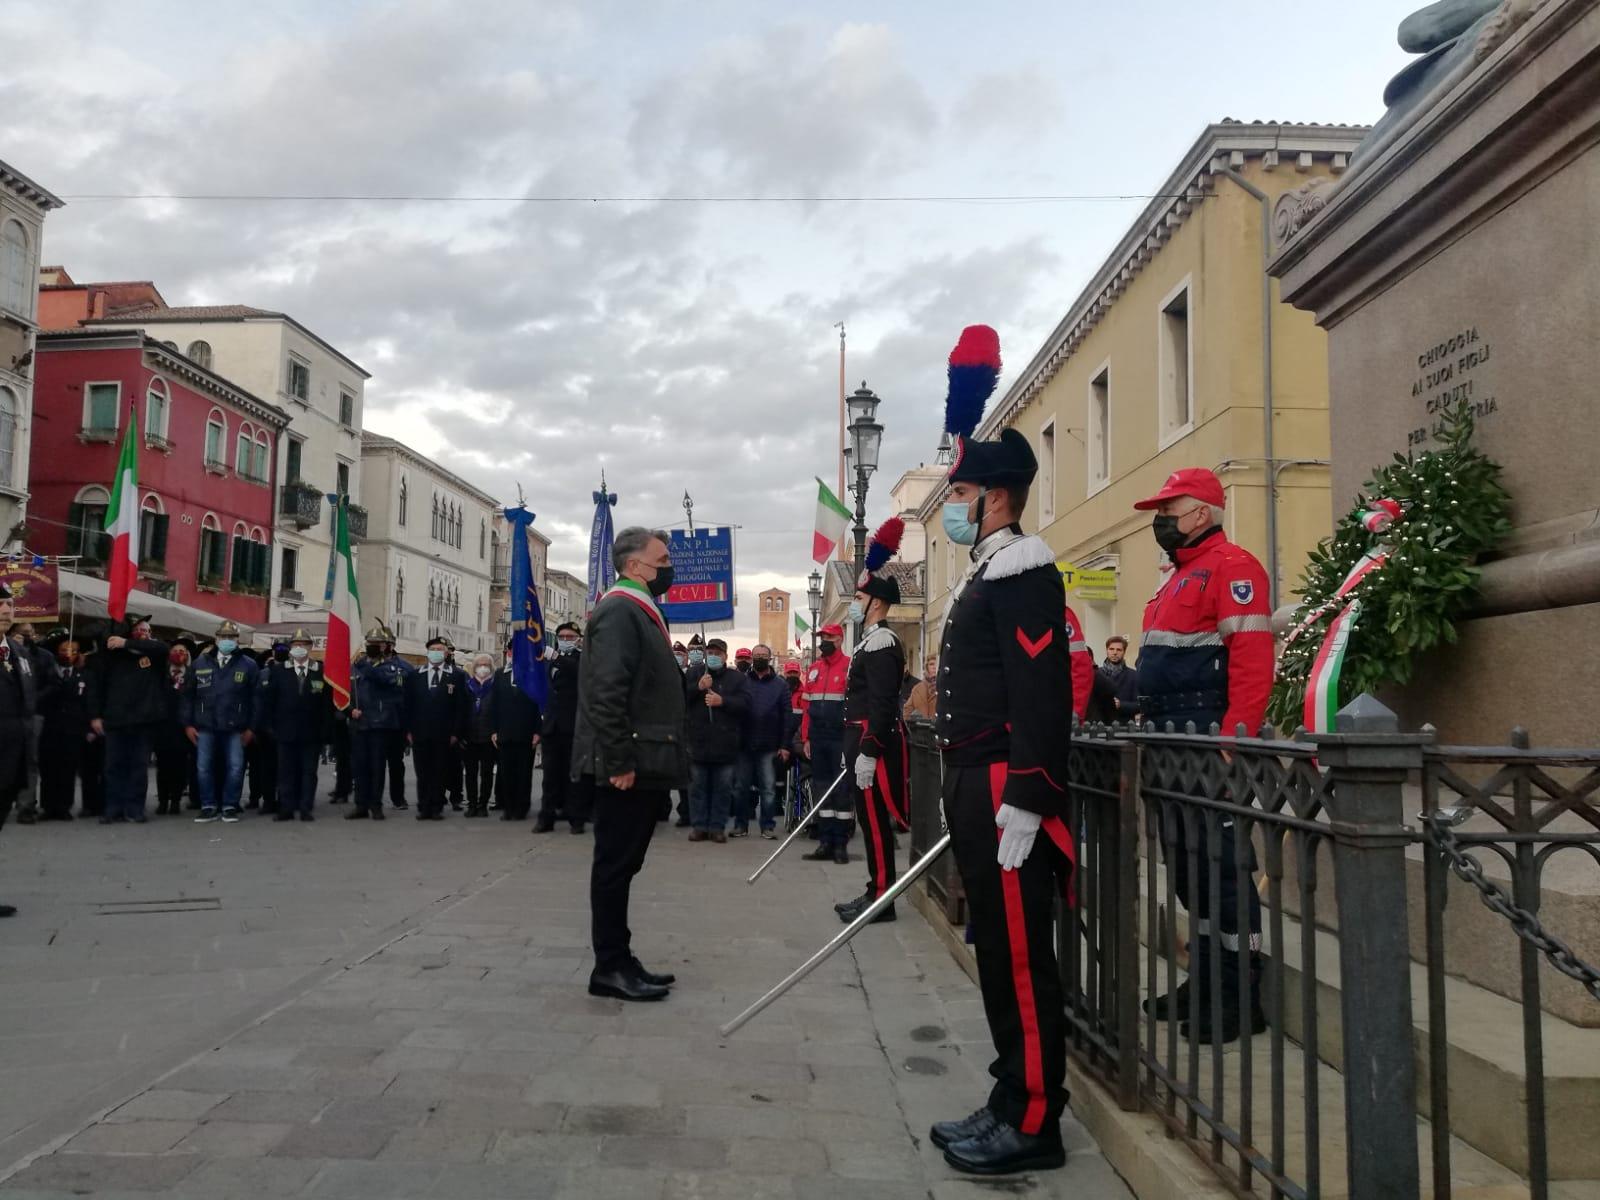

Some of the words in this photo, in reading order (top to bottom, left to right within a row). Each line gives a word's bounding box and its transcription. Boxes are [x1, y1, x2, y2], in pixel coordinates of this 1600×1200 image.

[1418, 327, 1479, 368] CHIOGGIA
[1411, 379, 1422, 397] AI
[1426, 364, 1453, 391] SUOI
[1458, 344, 1490, 374] FIGLI
[1425, 380, 1473, 414] CADUTI
[697, 549, 728, 557] NAZIONALE
